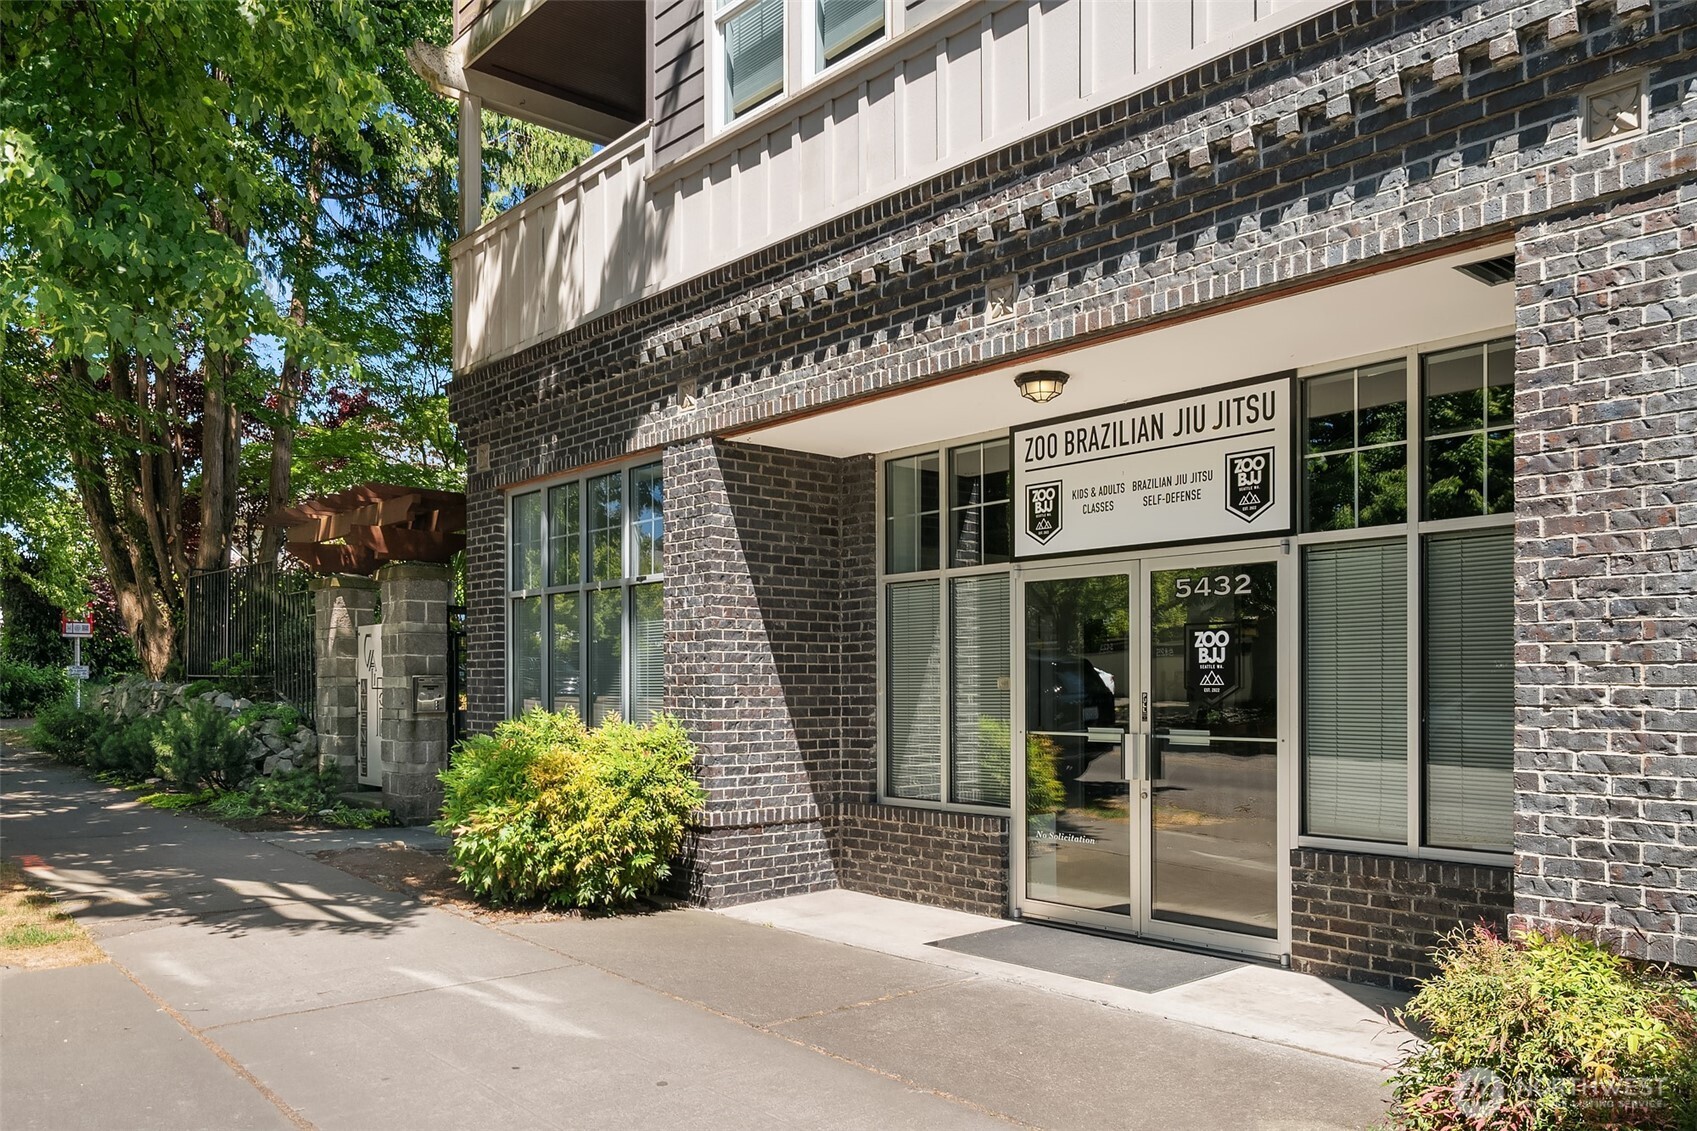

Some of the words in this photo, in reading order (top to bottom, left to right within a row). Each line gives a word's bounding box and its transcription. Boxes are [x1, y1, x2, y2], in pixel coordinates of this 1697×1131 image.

[1025, 433, 1058, 463] ZOO
[1065, 412, 1164, 456] BRAZILIAN
[1172, 404, 1206, 437] JIU
[1212, 390, 1276, 430] JITSU
[1234, 456, 1266, 474] ZOO
[1132, 476, 1172, 492] BRAZILIAN
[1175, 473, 1188, 486] JIU
[1190, 470, 1213, 484] JITSU
[1238, 470, 1262, 487] BJJ
[1032, 487, 1056, 503] ZOO
[1072, 488, 1089, 500] KIDS
[1091, 487, 1097, 498] &
[1098, 483, 1125, 497] ADULTS
[1143, 489, 1202, 506] SELF-DEFENSE
[1035, 500, 1053, 514] BJJ
[1082, 501, 1114, 514] CLASSES
[1175, 573, 1252, 598] 5432
[1194, 630, 1230, 648] ZOO
[1198, 647, 1226, 664] BJJ
[1036, 830, 1047, 839] No
[1049, 831, 1096, 845] Solicitation
